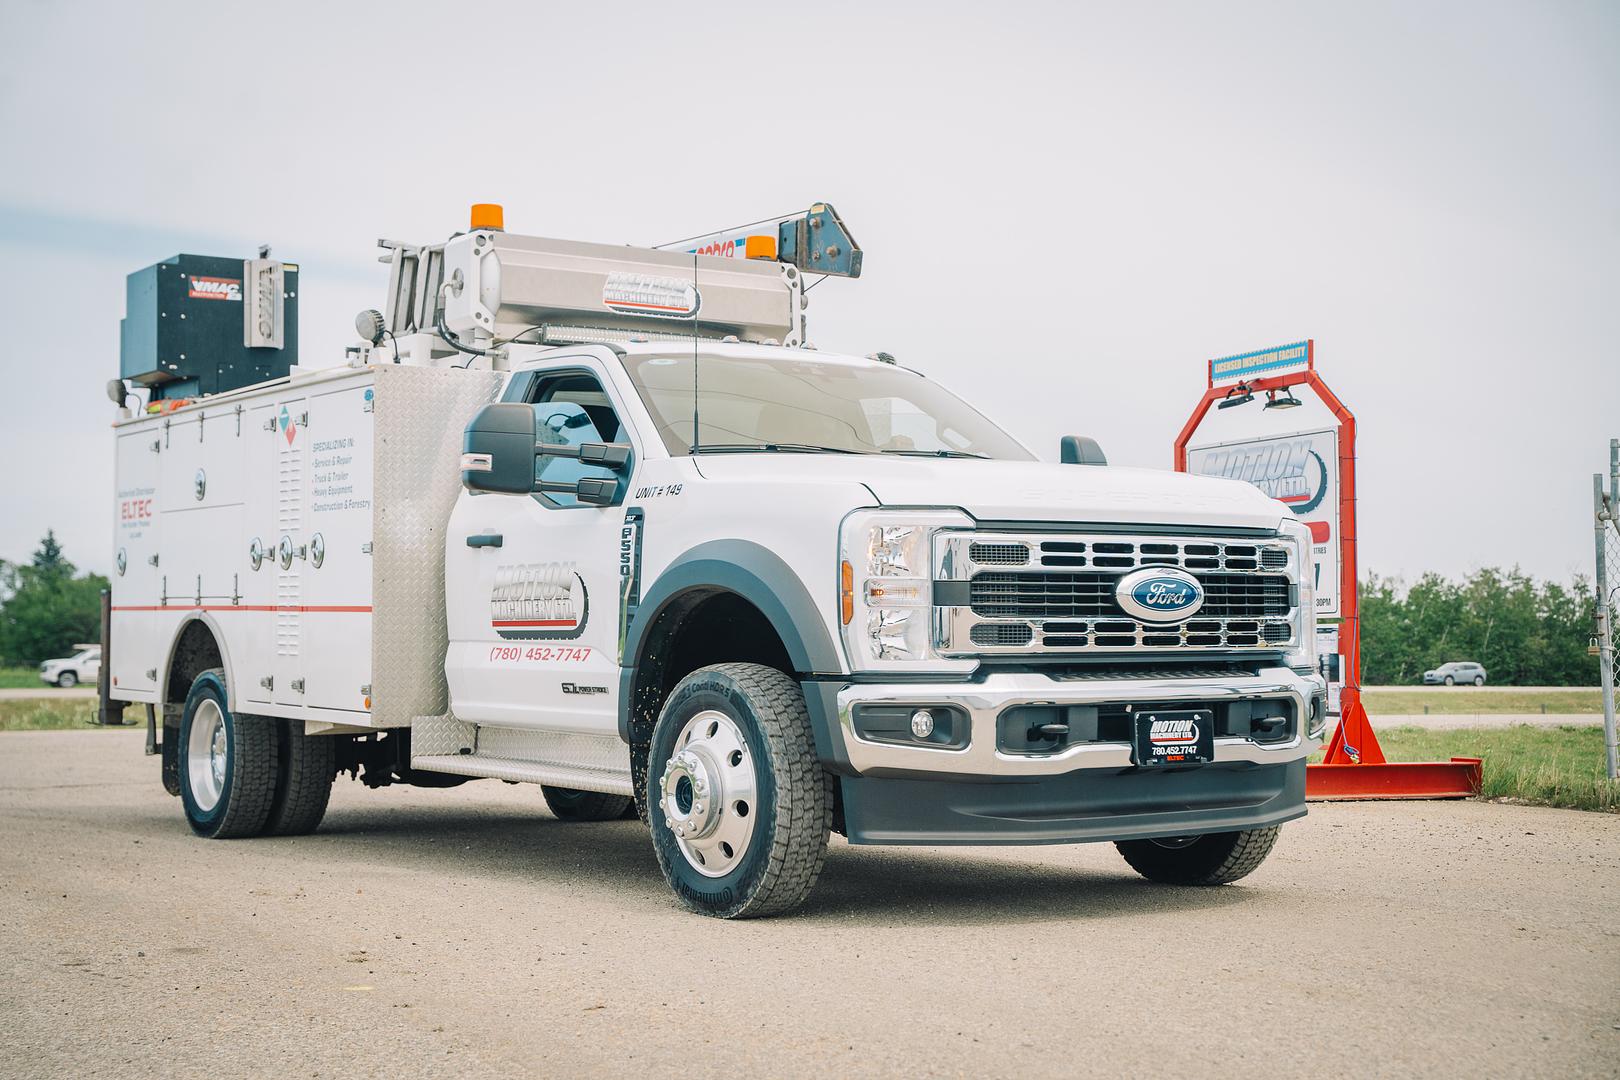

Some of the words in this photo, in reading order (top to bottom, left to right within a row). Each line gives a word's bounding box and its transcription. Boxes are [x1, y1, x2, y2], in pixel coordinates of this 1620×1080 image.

[191, 280, 240, 293] VMAC
[1279, 346, 1306, 362] FACILITY
[1202, 440, 1312, 482] MOTION
[636, 486, 658, 499] UNIT
[666, 483, 683, 496] 149
[121, 499, 152, 520] ELTEC
[348, 499, 370, 511] Forestry
[494, 562, 577, 601] MOTION
[1146, 582, 1187, 605] Ford
[491, 598, 553, 620] MACHINERY
[490, 647, 522, 662] (780)
[526, 648, 592, 662] 452-7747
[1150, 720, 1194, 733] MOTION
[1151, 745, 1198, 756] 780.452.7747
